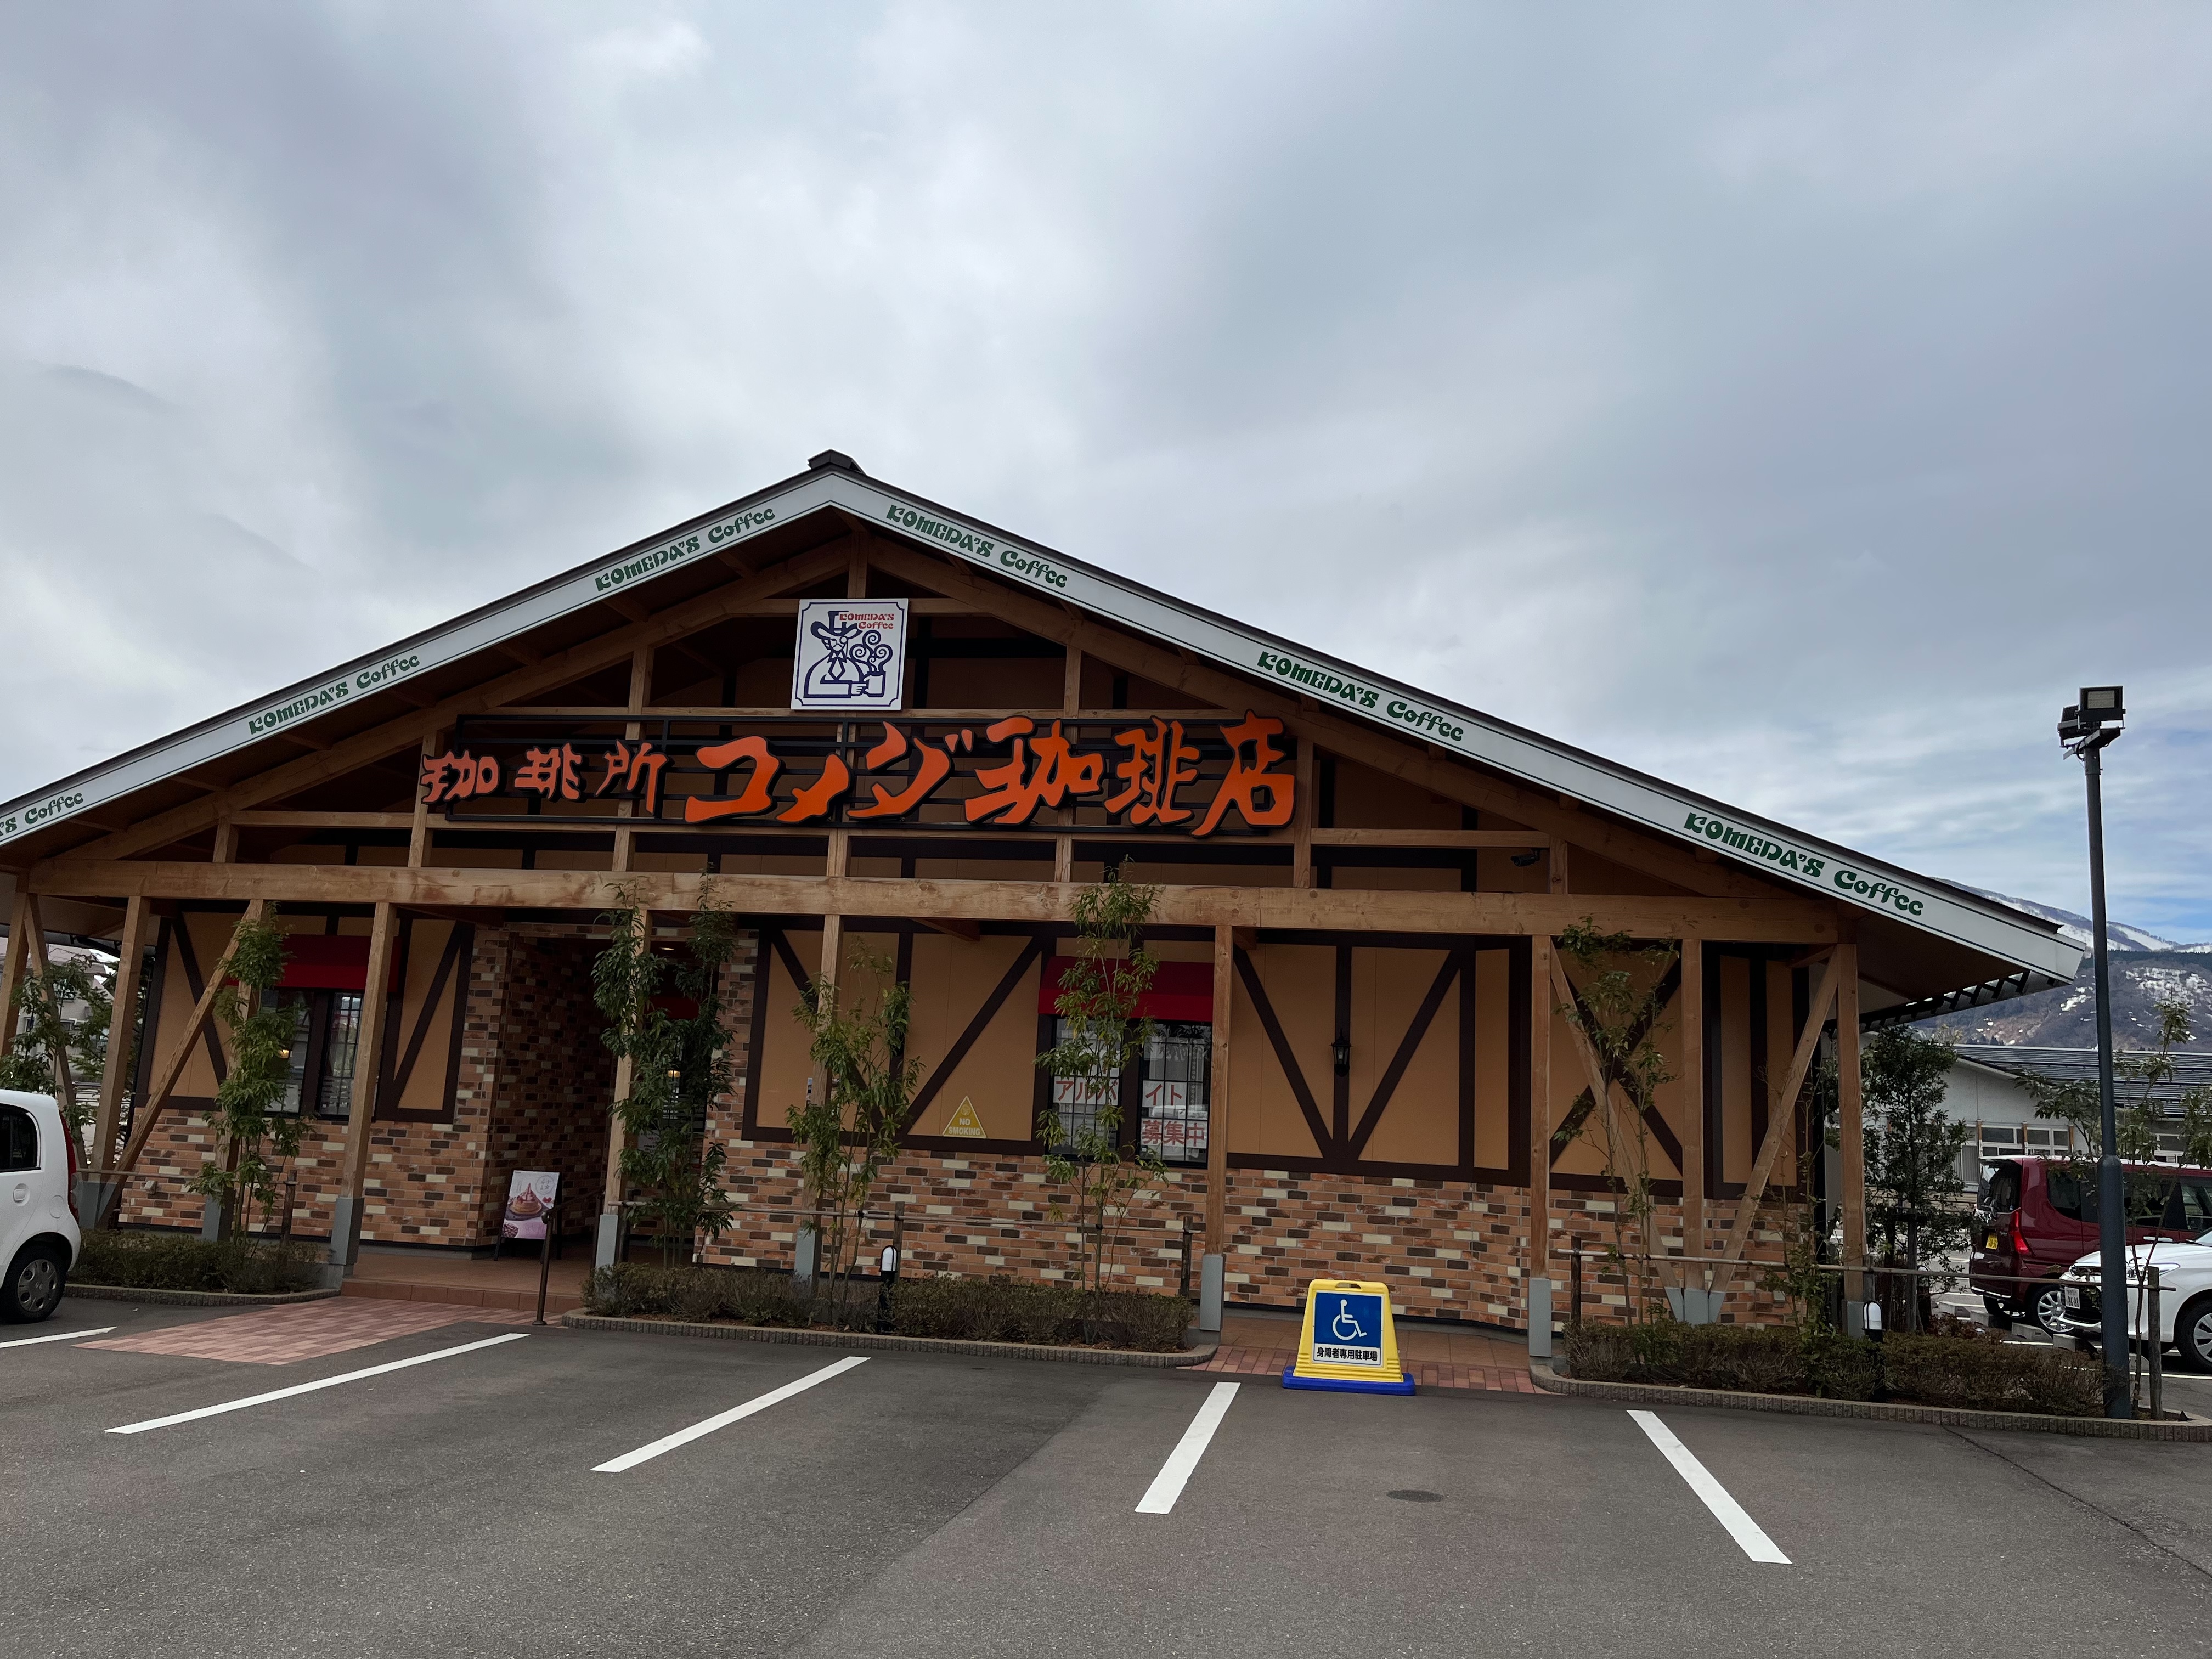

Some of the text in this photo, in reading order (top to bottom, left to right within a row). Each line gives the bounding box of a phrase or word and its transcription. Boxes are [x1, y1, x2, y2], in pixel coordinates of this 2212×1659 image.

[595, 507, 776, 592] KOMEDA'S Coffee
[886, 504, 1068, 589] KOMEDA'S Coffee
[248, 654, 421, 735] KOMEDA'S Coffee
[1256, 651, 1464, 742] KOMEDA'S Coffee
[25, 793, 84, 825] Coffee
[1684, 812, 1924, 917] KOMEDA'S Coffee
[948, 1126, 980, 1136] SMOKING
[959, 1118, 971, 1126] NO
[1142, 1119, 1205, 1147] 募集中
[1317, 1347, 1378, 1361] 身障者専用駐車場
